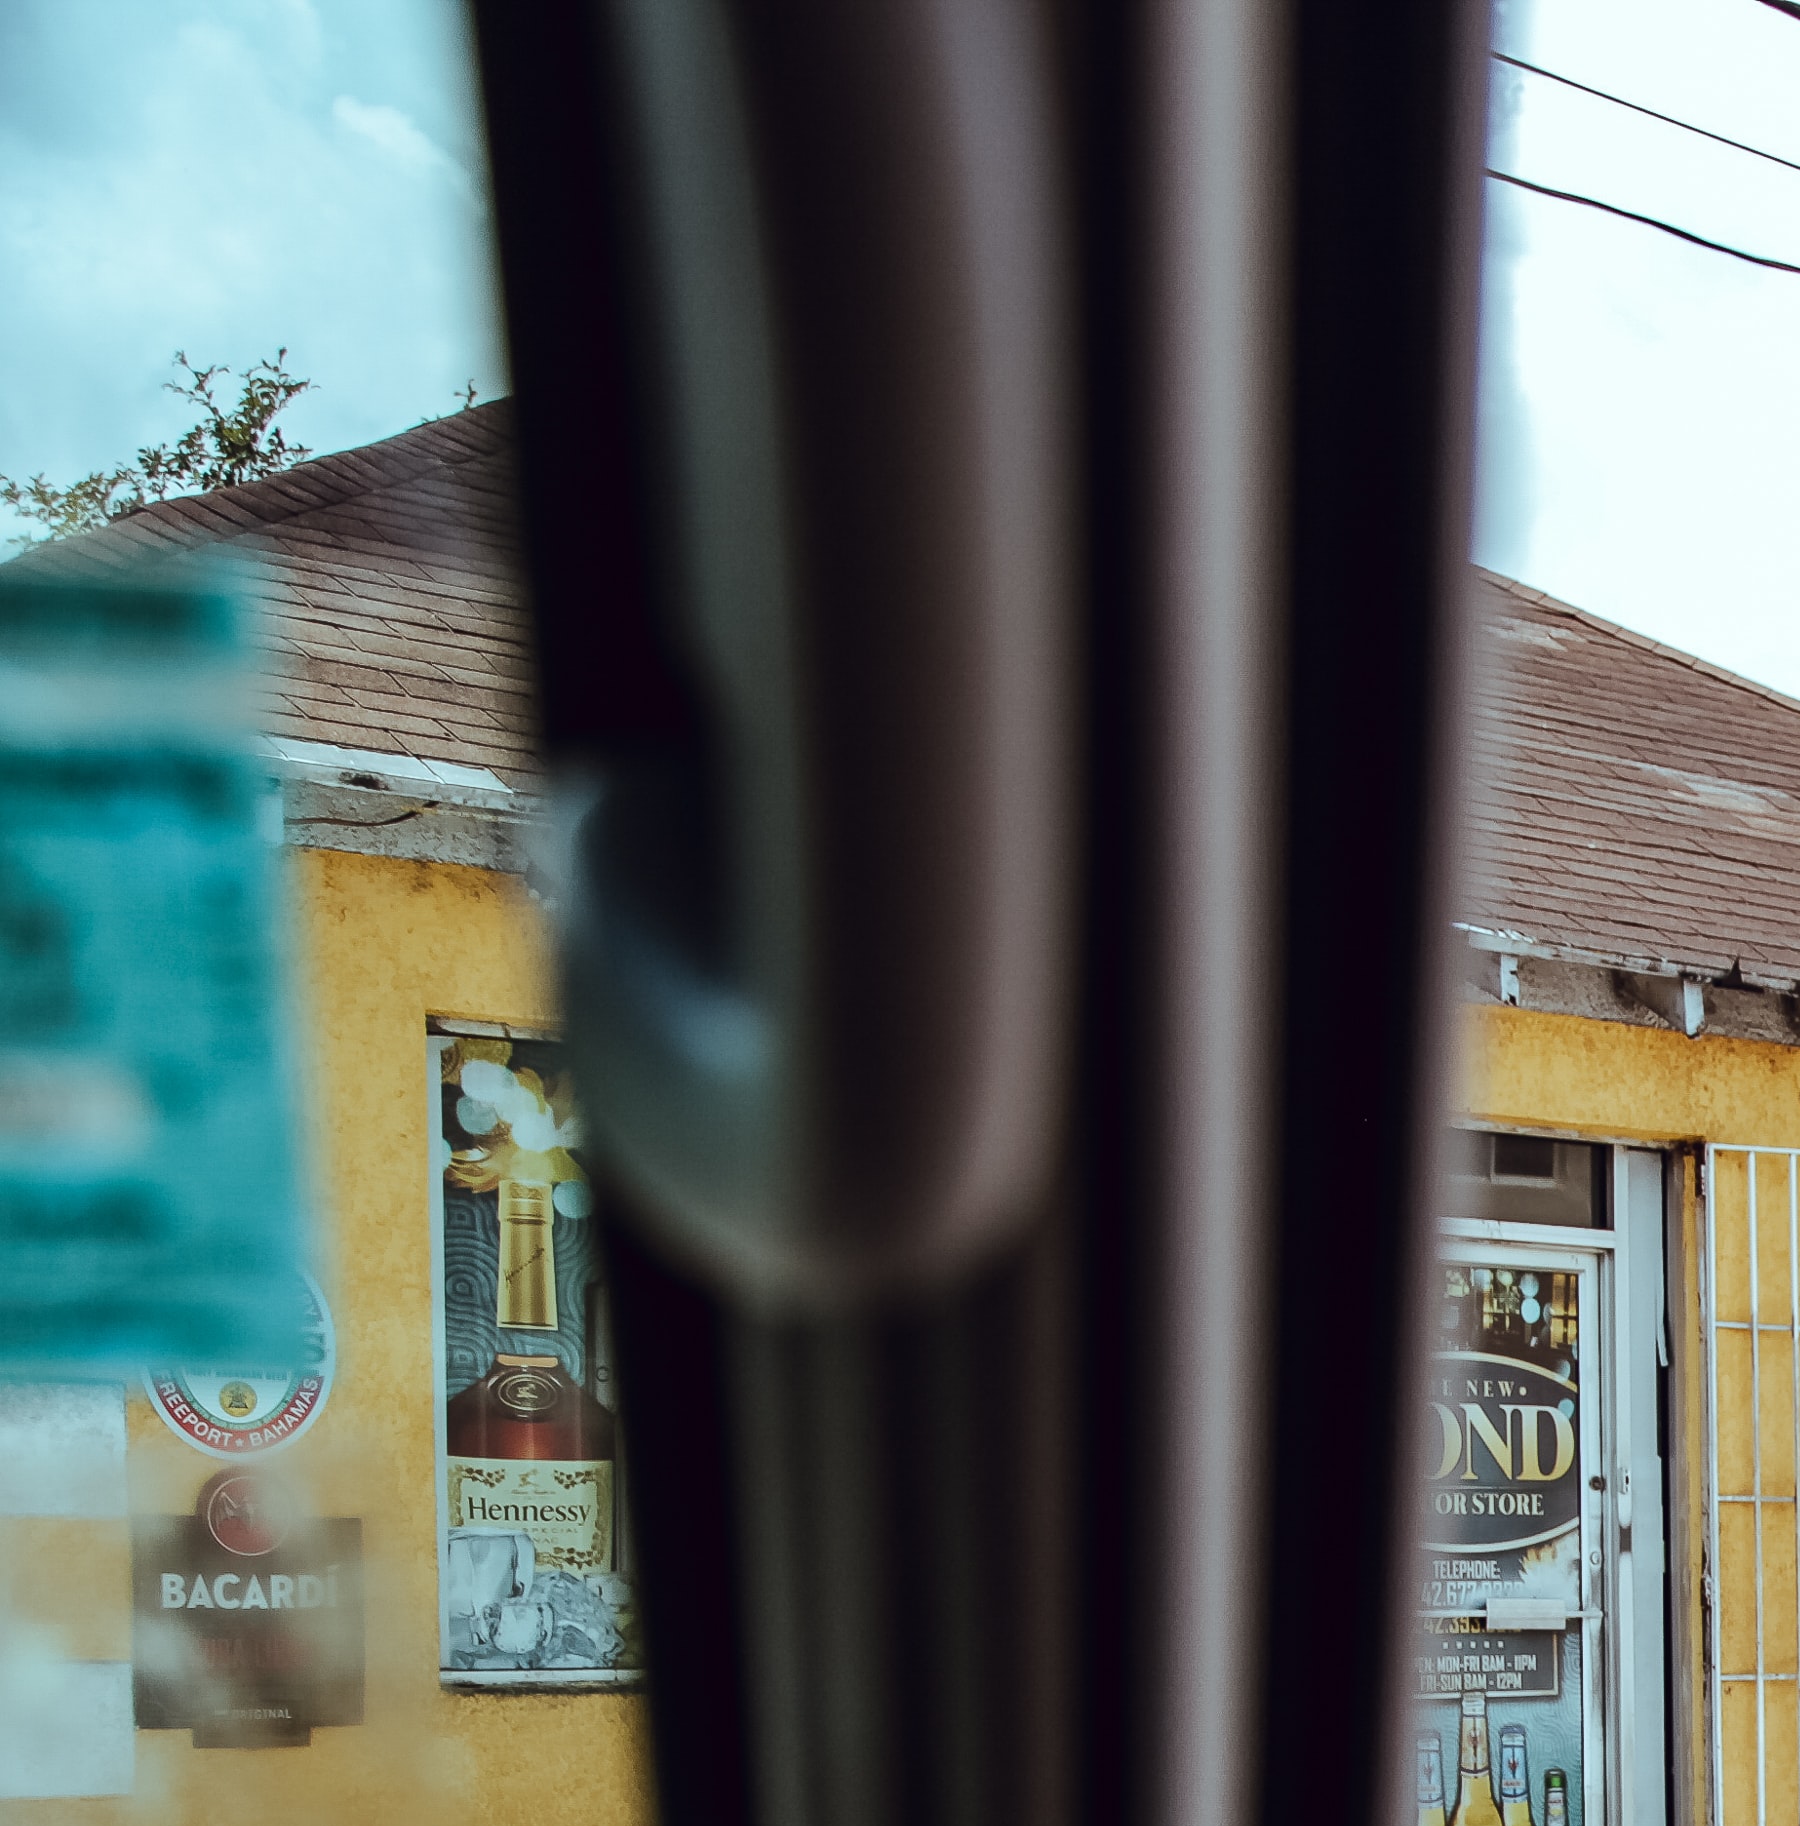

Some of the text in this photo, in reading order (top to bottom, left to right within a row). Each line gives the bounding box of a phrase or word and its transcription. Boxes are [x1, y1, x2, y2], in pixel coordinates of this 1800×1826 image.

[1466, 1380, 1514, 1398] NEW
[249, 1377, 319, 1447] BAHAMAS
[467, 1496, 592, 1526] Hennessy
[1471, 1493, 1545, 1516] STORE
[1433, 1560, 1501, 1580] TELEPHONE:
[1437, 1655, 1480, 1673] MON-FRI
[1482, 1655, 1505, 1672] 8AM
[1514, 1654, 1537, 1671] 11PM
[1464, 1672, 1487, 1690] 8AM
[1496, 1672, 1522, 1690] 12PM
